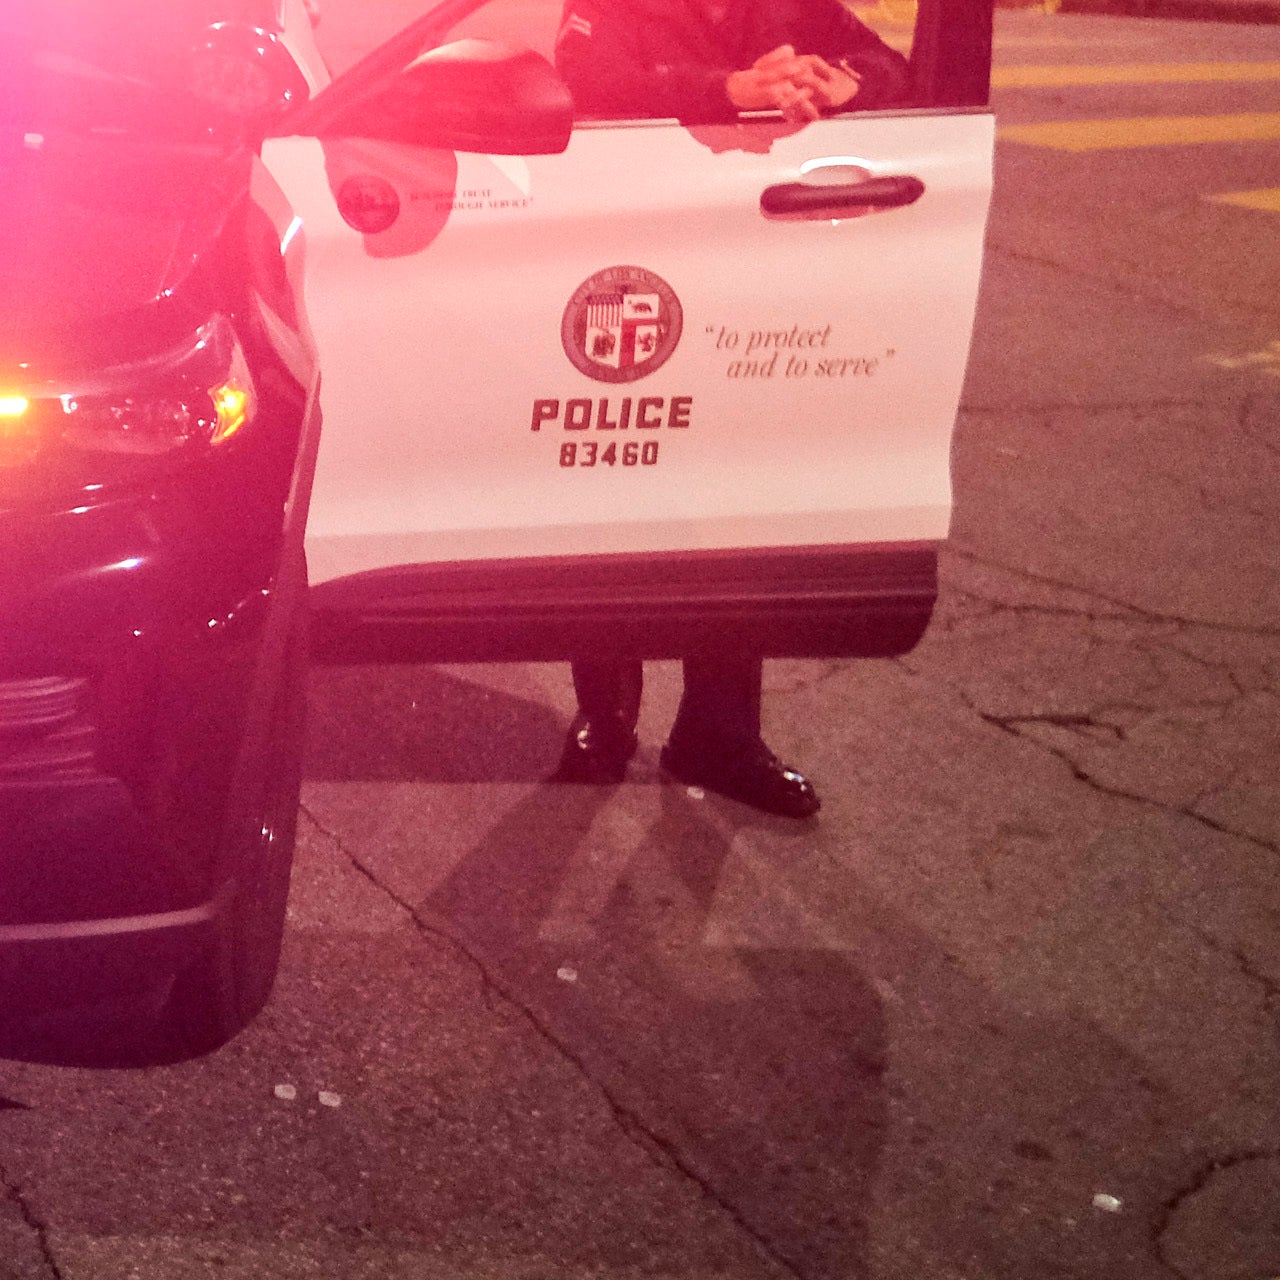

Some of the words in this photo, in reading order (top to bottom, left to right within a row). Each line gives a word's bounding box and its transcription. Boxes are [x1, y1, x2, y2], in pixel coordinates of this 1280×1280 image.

[746, 323, 831, 356] protect
[727, 351, 778, 378] and
[785, 354, 808, 377] to
[530, 396, 693, 432] POLICE
[559, 441, 659, 467] 83460
